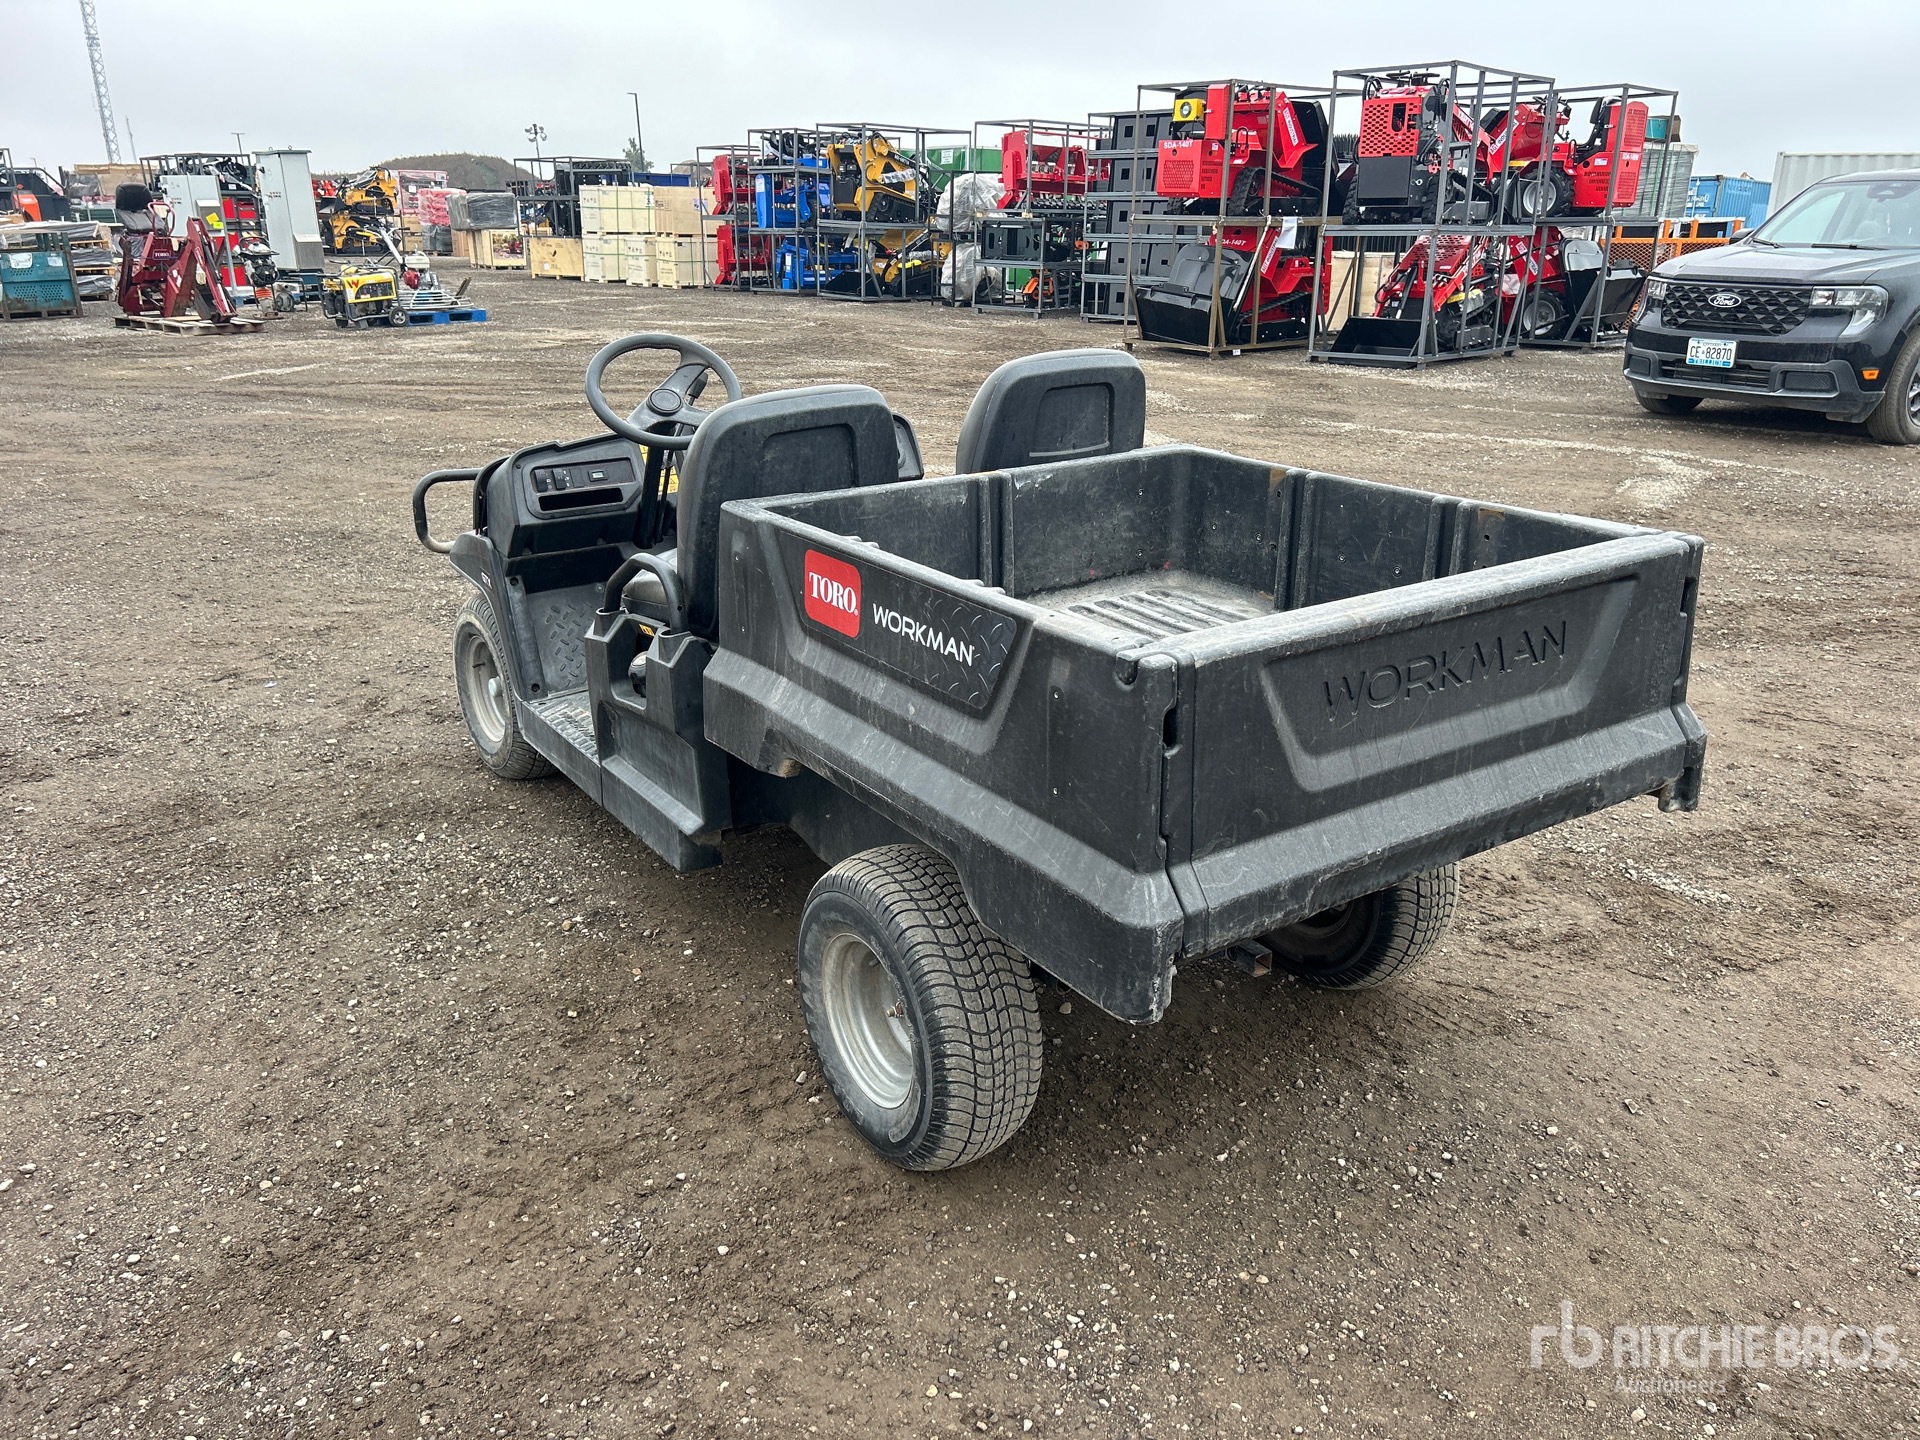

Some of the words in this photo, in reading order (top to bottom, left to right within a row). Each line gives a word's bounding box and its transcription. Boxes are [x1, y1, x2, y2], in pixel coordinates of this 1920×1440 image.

[1163, 140, 1193, 149] SDA-140T
[1713, 295, 1736, 306] Ford
[1690, 346, 1701, 359] CE
[1705, 347, 1732, 361] 82870
[808, 571, 858, 615] TORO
[872, 602, 974, 668] WORKMAN
[1322, 620, 1567, 723] WORKMAN
